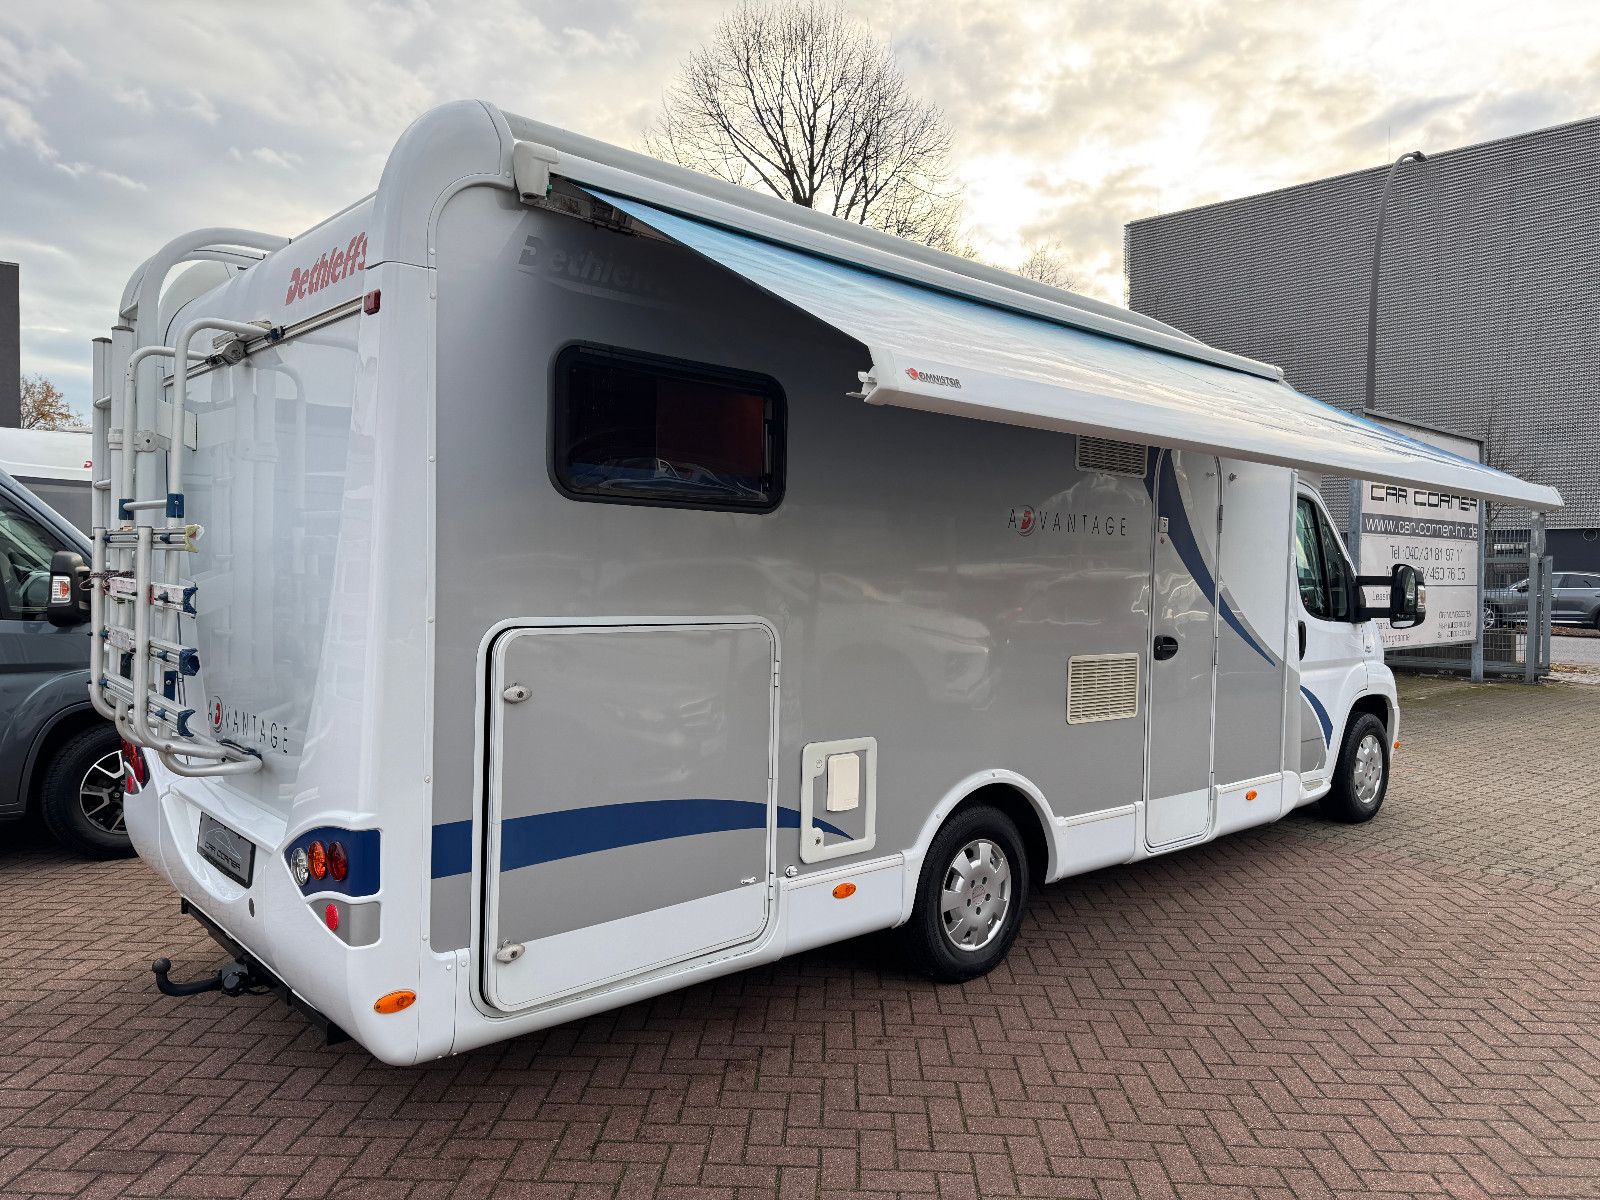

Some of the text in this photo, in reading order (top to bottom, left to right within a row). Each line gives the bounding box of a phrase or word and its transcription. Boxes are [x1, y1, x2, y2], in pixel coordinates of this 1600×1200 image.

[285, 231, 369, 306] Dethleffs
[918, 371, 962, 389] OMNISTOR
[1370, 484, 1478, 512] CAR CORNER
[1007, 505, 1126, 536] ADVANTAGE
[207, 695, 288, 754] ADVANTAGE
